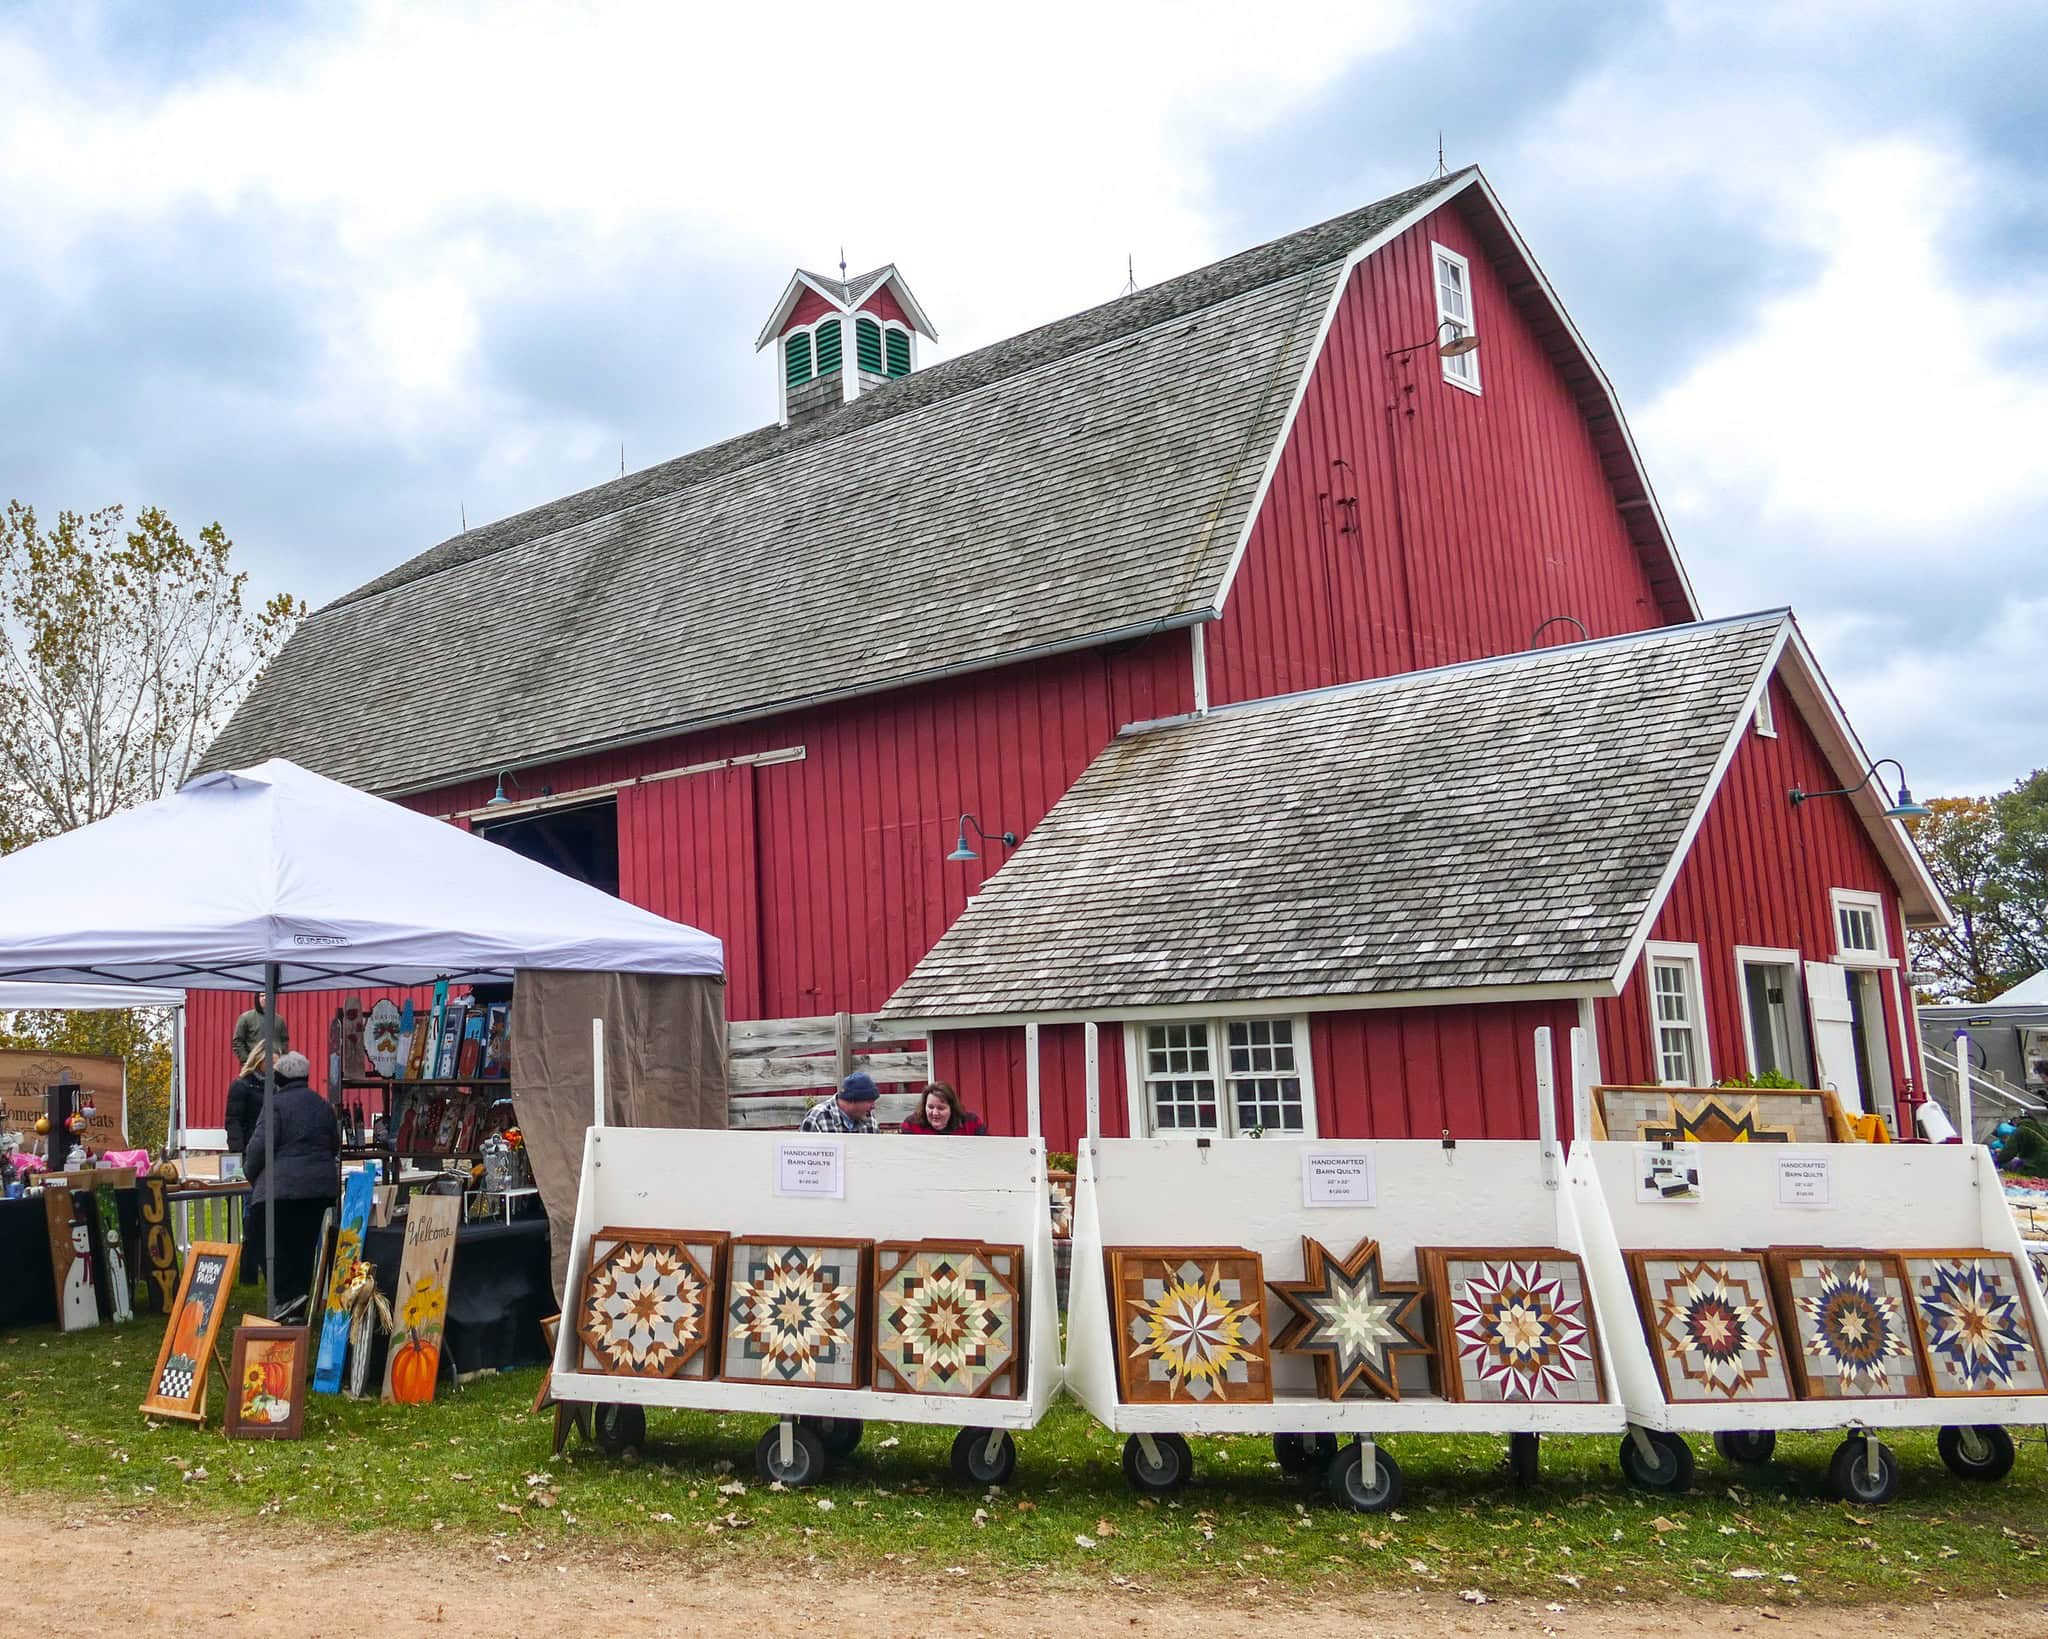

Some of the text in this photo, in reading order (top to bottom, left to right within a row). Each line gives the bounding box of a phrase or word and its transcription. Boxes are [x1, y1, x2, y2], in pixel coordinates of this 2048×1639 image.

[13, 1081, 40, 1097] AK'S
[143, 1179, 177, 1313] JOY
[408, 1216, 454, 1247] Welcome
